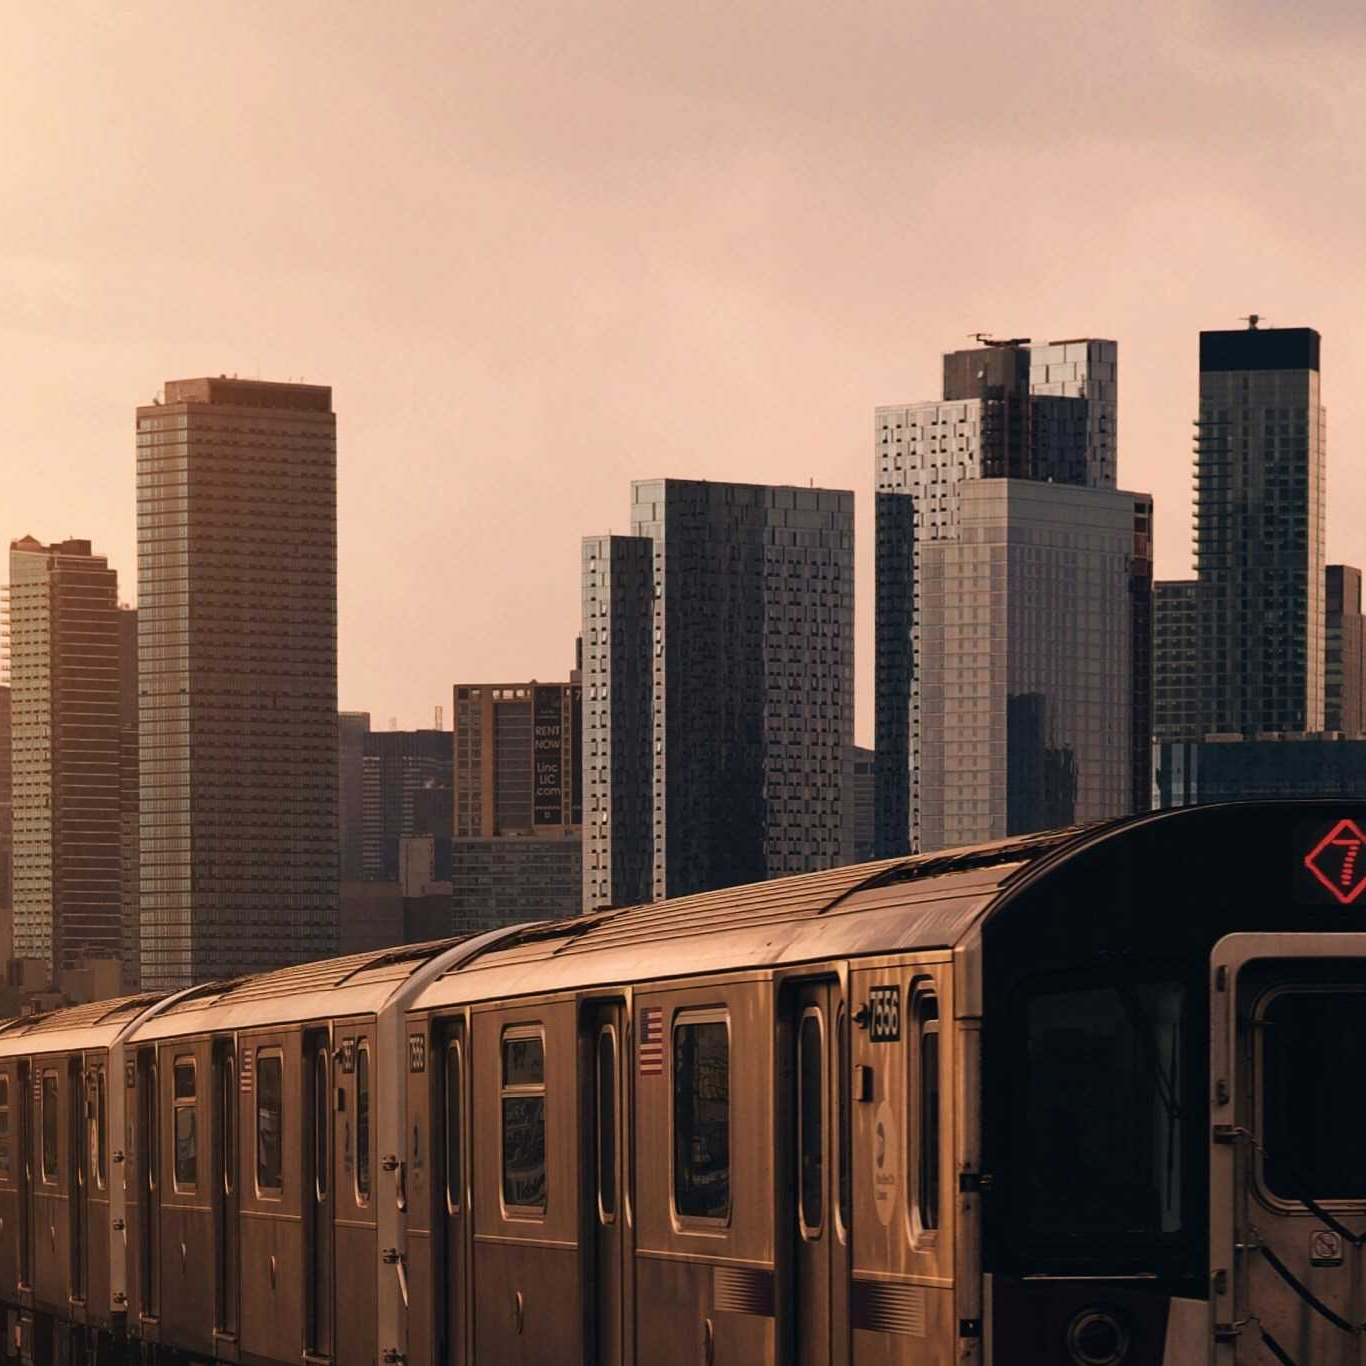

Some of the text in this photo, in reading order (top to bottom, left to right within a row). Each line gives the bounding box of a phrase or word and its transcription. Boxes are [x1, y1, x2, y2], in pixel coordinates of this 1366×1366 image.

[535, 725, 560, 736] RENT
[535, 739, 561, 749] NOW
[537, 761, 559, 773] Linc
[1330, 839, 1362, 887] 7
[870, 991, 899, 1036] 7556
